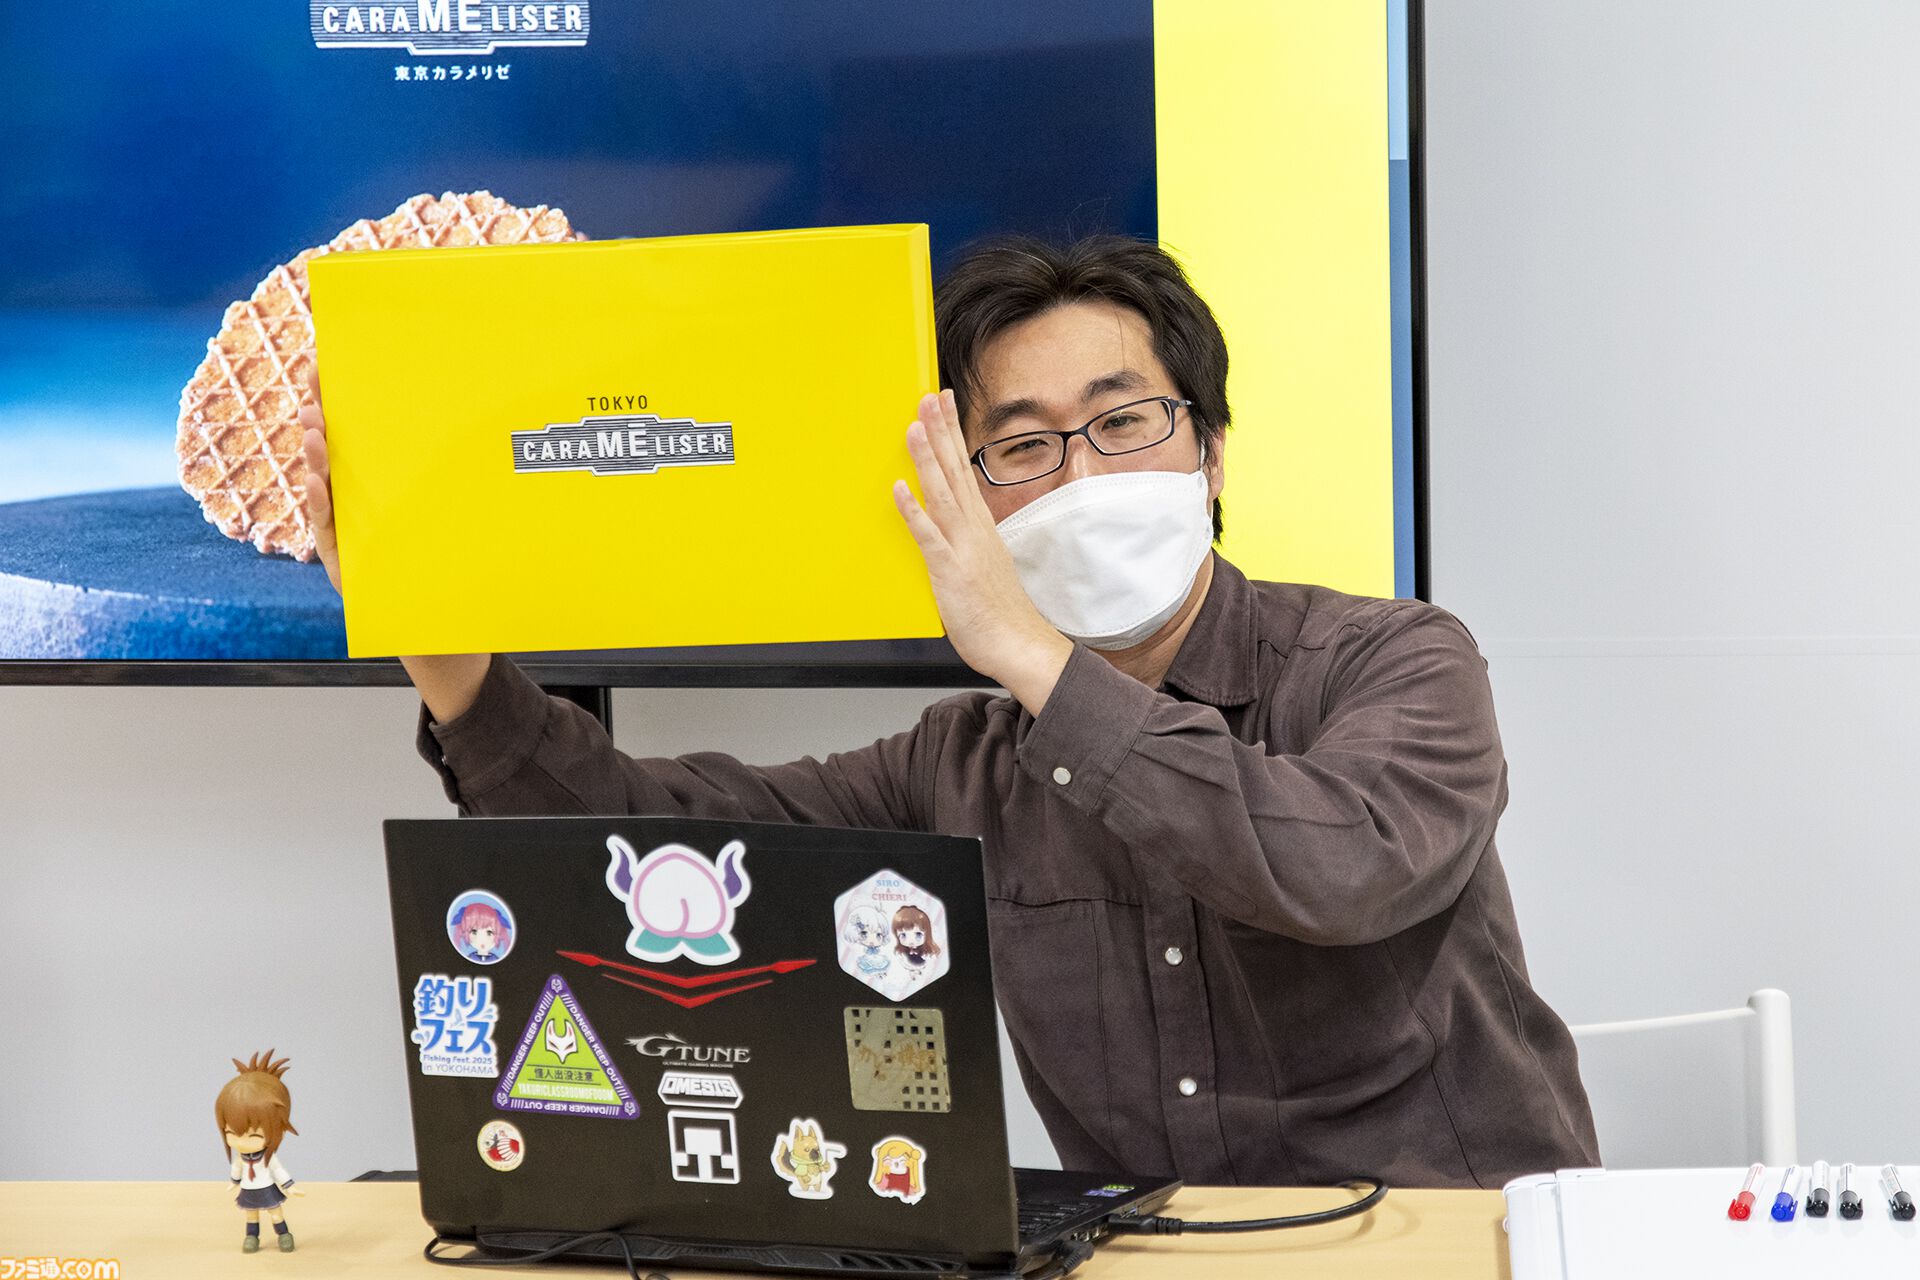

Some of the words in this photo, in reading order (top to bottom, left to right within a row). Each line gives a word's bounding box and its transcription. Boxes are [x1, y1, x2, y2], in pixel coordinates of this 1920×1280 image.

[394, 64, 511, 81] 東京カラメリゼ
[586, 395, 649, 411] TOKYO
[876, 879, 900, 887] SIRO
[871, 893, 907, 901] CHIERI
[418, 978, 488, 1019] 釣り
[420, 1019, 491, 1054] フェス
[569, 1005, 596, 1046] DANGER
[592, 1043, 610, 1069] KEEP
[508, 1045, 528, 1080] DANGER
[524, 1022, 540, 1046] KEEP
[423, 1055, 451, 1064] Fishing
[435, 1063, 494, 1075] YOKOHAMA
[544, 1102, 567, 1111] KEEP
[569, 1103, 607, 1115] DANGER
